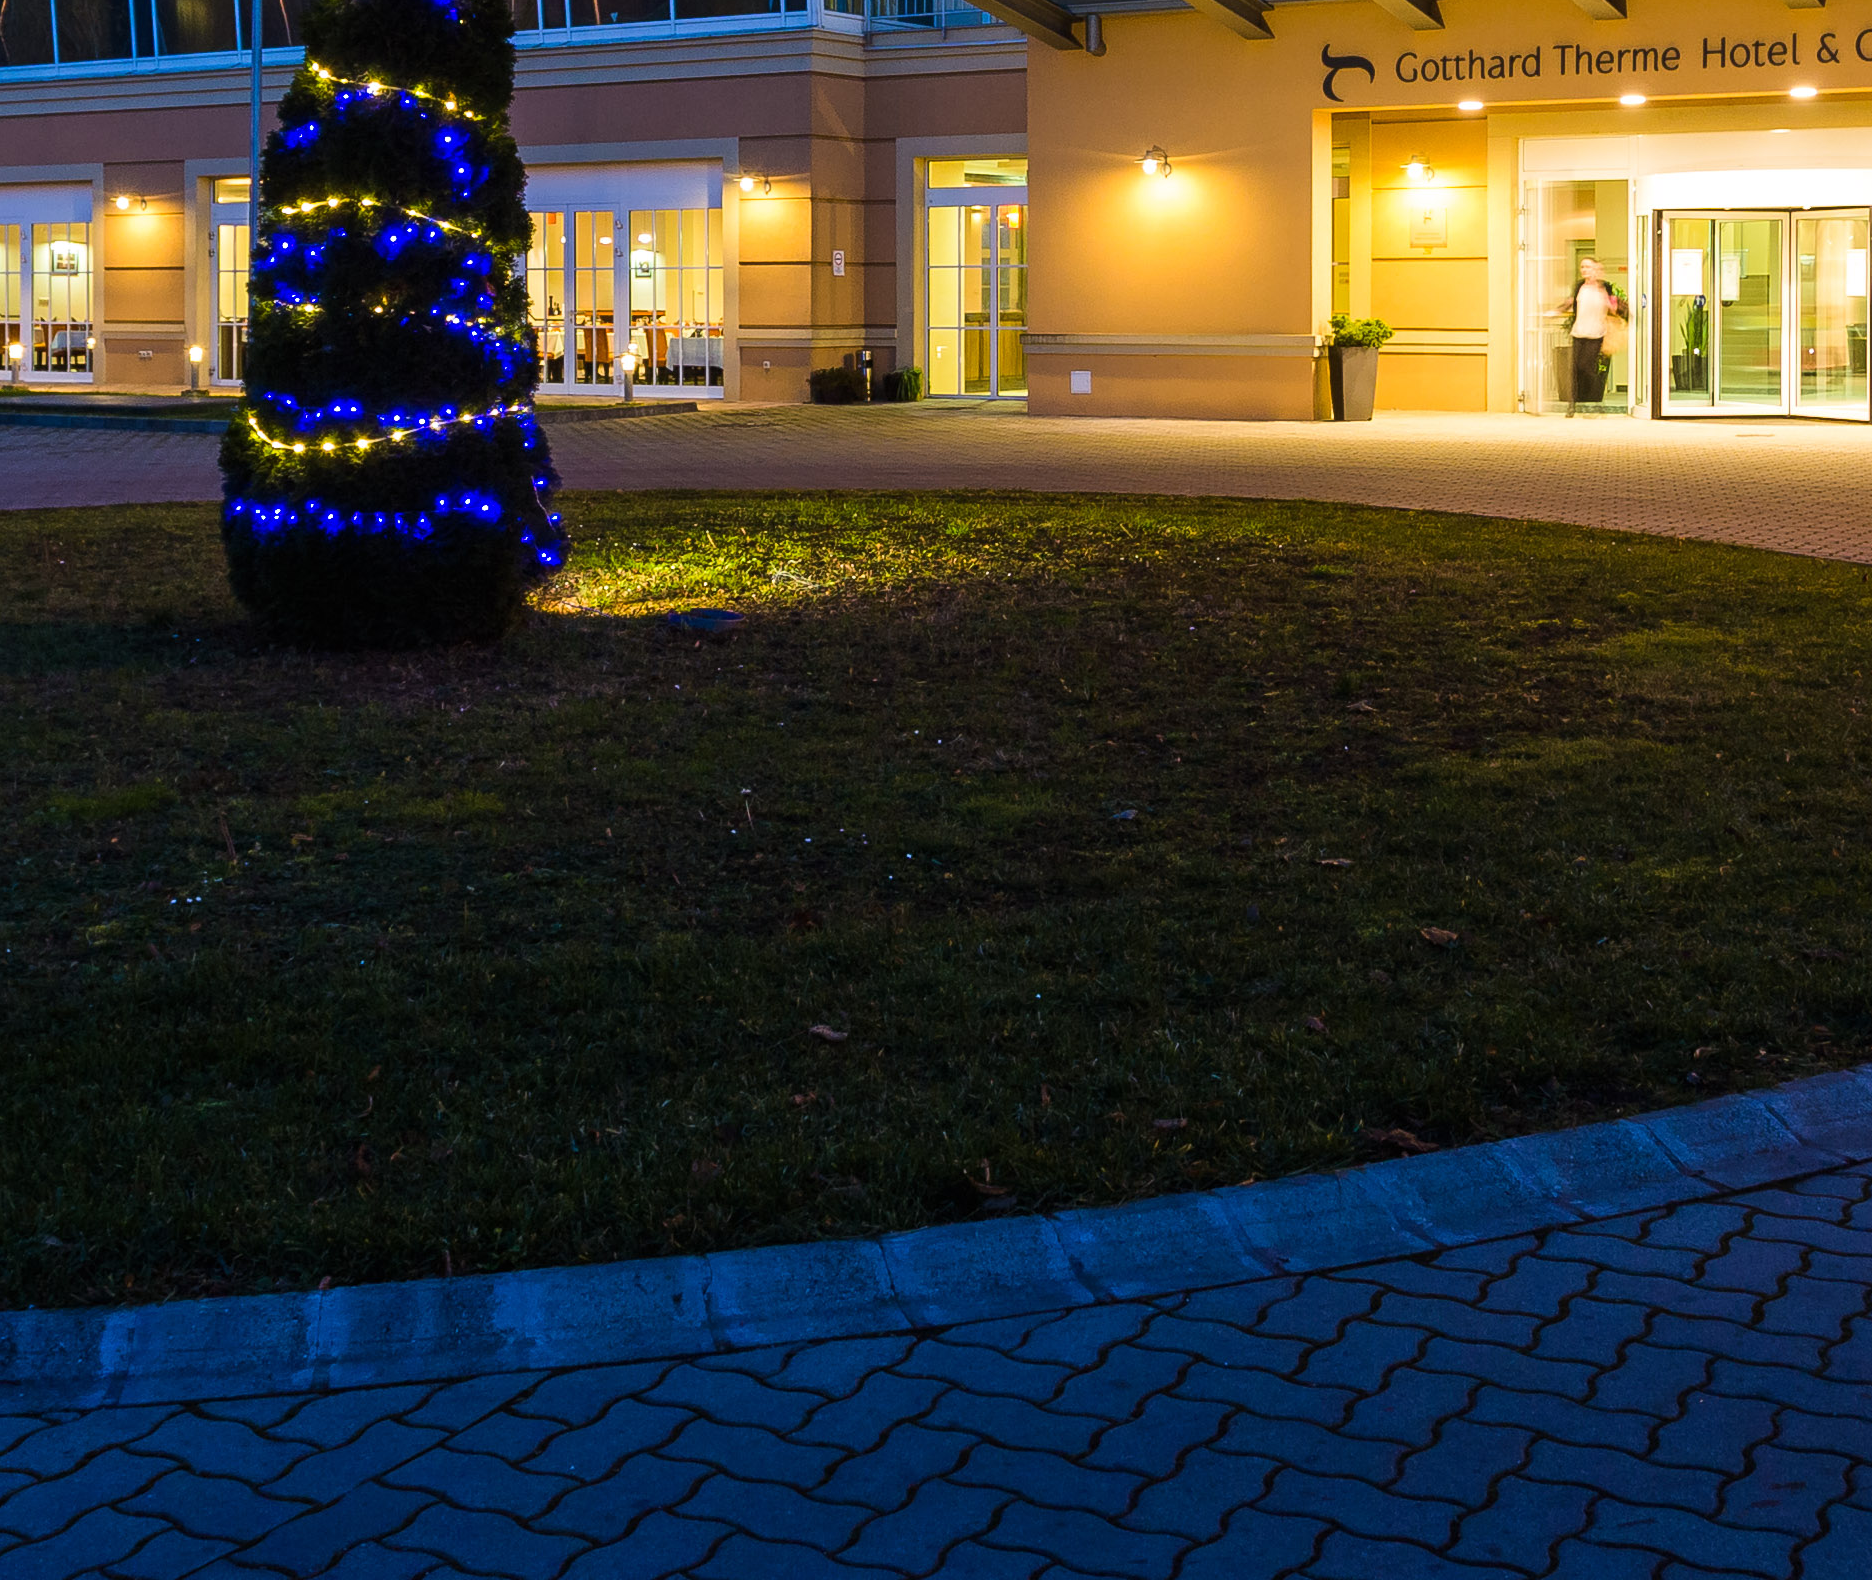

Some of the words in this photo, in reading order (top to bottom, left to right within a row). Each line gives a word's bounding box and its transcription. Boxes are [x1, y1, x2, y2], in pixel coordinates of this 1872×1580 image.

[1395, 45, 1542, 84] Gotthard
[1552, 43, 1682, 77] Therme
[1702, 32, 1801, 70] Hotel
[1816, 32, 1841, 65] &
